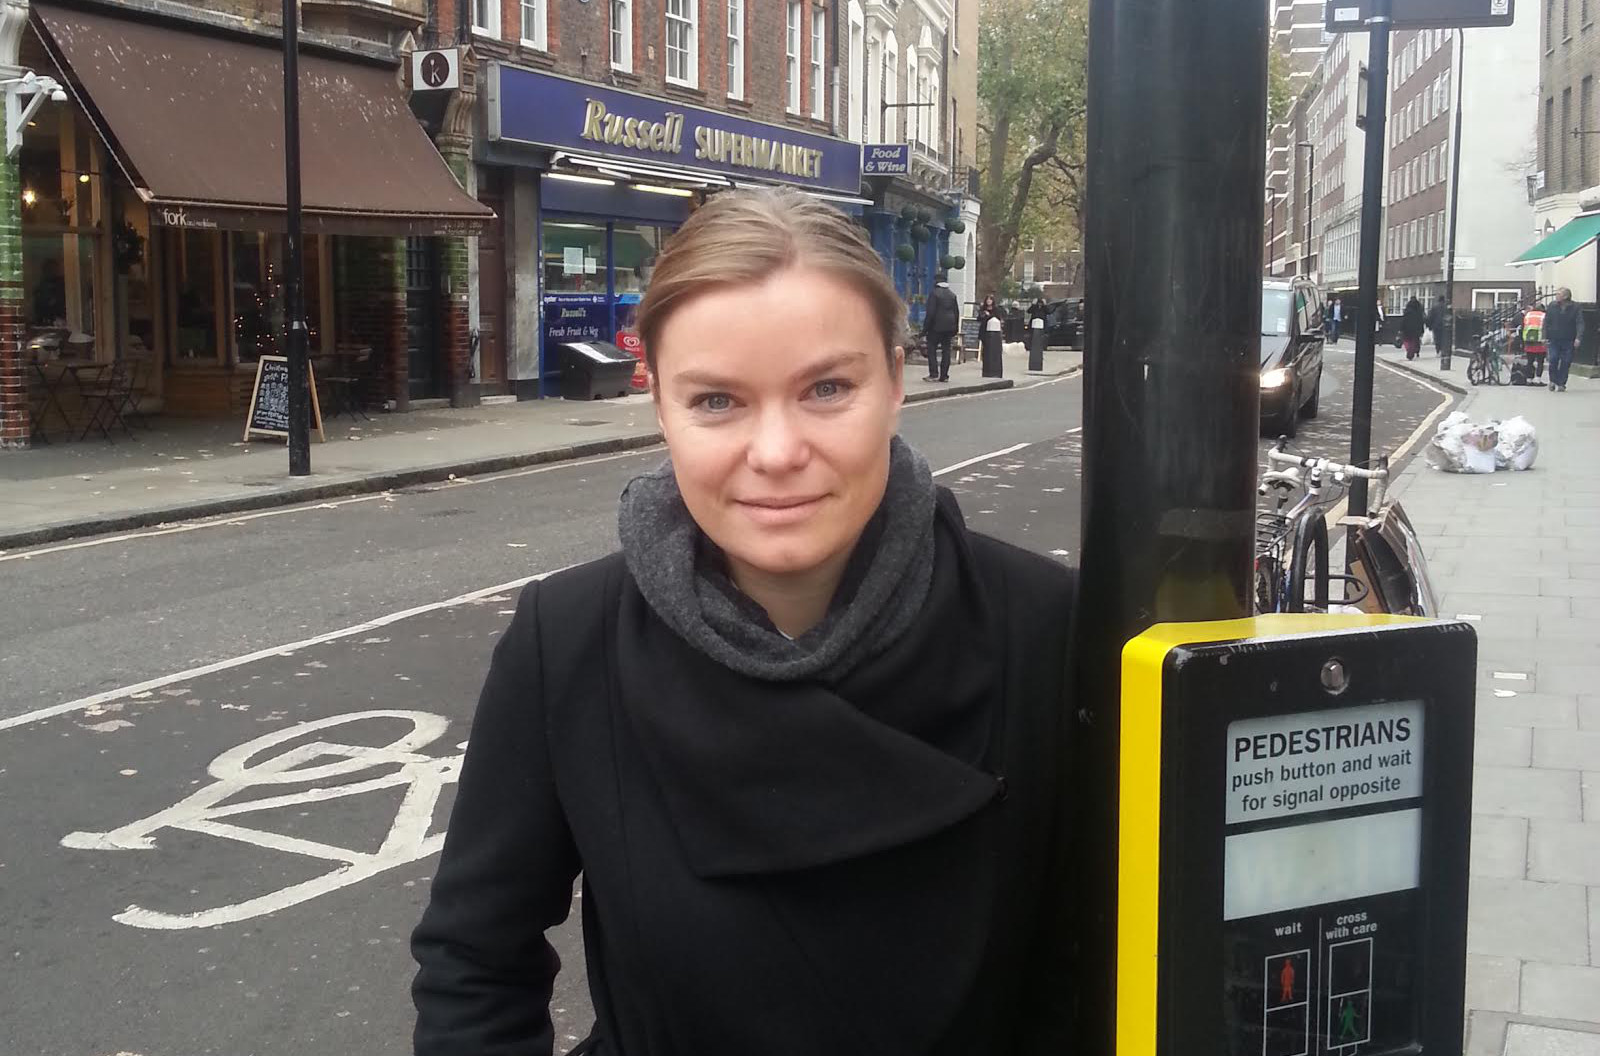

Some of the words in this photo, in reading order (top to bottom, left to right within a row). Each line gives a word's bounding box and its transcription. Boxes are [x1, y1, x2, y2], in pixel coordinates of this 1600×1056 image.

[580, 98, 684, 154] Russell
[695, 125, 823, 179] SUPERMARKET
[871, 147, 901, 159] Food
[865, 161, 875, 172] &
[877, 161, 906, 172] Wine
[162, 207, 187, 226] fork
[549, 327, 565, 337] Fresh
[567, 326, 582, 336] Fruit
[589, 326, 599, 338] Veg
[1234, 717, 1411, 763] PEDESTRIANS
[1232, 767, 1274, 792] push
[1280, 761, 1336, 782] button
[1341, 754, 1373, 774] and
[1378, 750, 1412, 769] wait
[1241, 794, 1267, 812] for
[1272, 785, 1324, 810] signal
[1329, 775, 1401, 802] opposite
[1336, 912, 1368, 926] cross
[1275, 922, 1303, 937] wait
[1325, 926, 1350, 940] with
[1352, 922, 1378, 936] care
